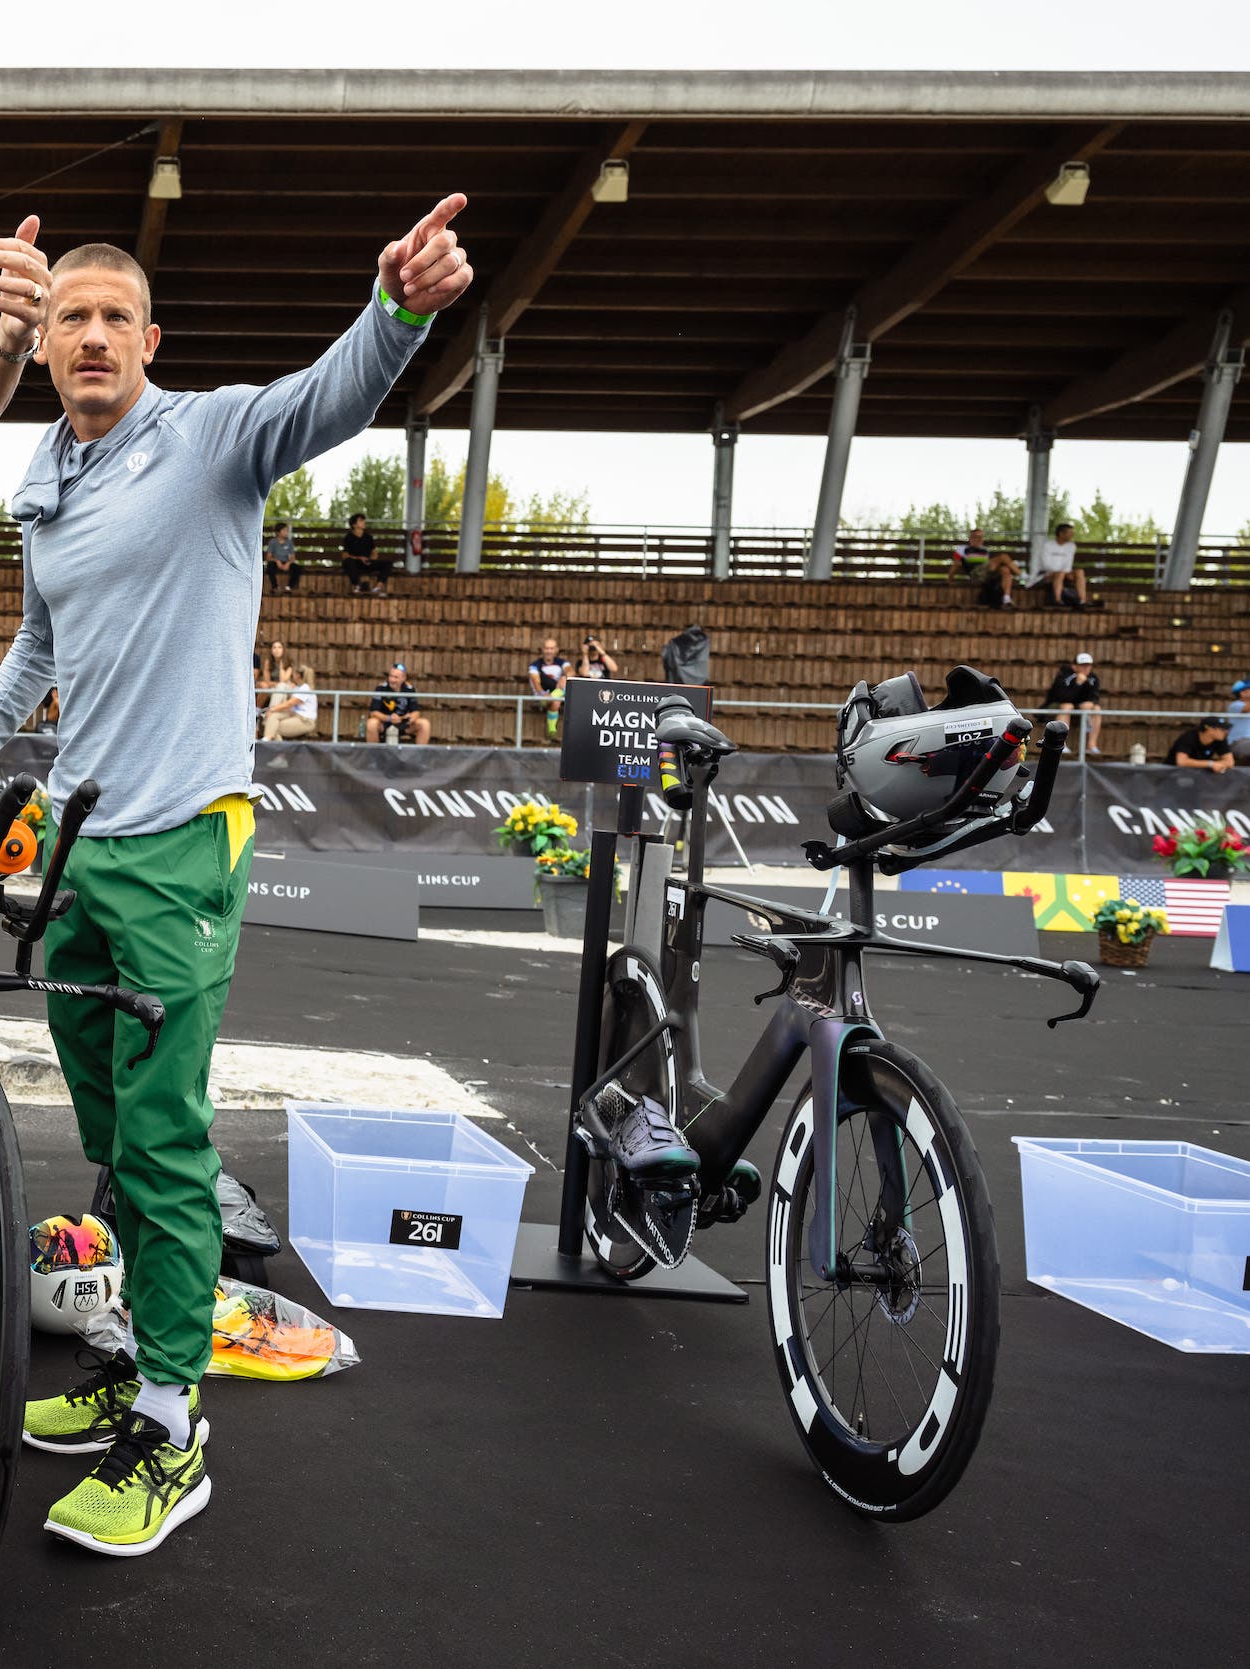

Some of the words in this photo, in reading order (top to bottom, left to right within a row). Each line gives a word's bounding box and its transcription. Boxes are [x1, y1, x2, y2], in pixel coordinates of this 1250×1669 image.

[616, 694, 659, 703] COLLINS
[591, 709, 657, 730] MAGN
[599, 730, 658, 750] DITLE
[618, 754, 651, 766] TEAM
[617, 764, 651, 779] EUR
[1108, 804, 1250, 838] CANYO
[418, 874, 450, 886] LINS
[451, 875, 481, 887] CUP
[272, 884, 311, 899] CUP
[891, 913, 940, 930] CUP
[28, 979, 83, 995] CANYON
[412, 1213, 441, 1221] COLLINS
[645, 1212, 674, 1265] WATTSHOP
[75, 1281, 98, 1294] 25H
